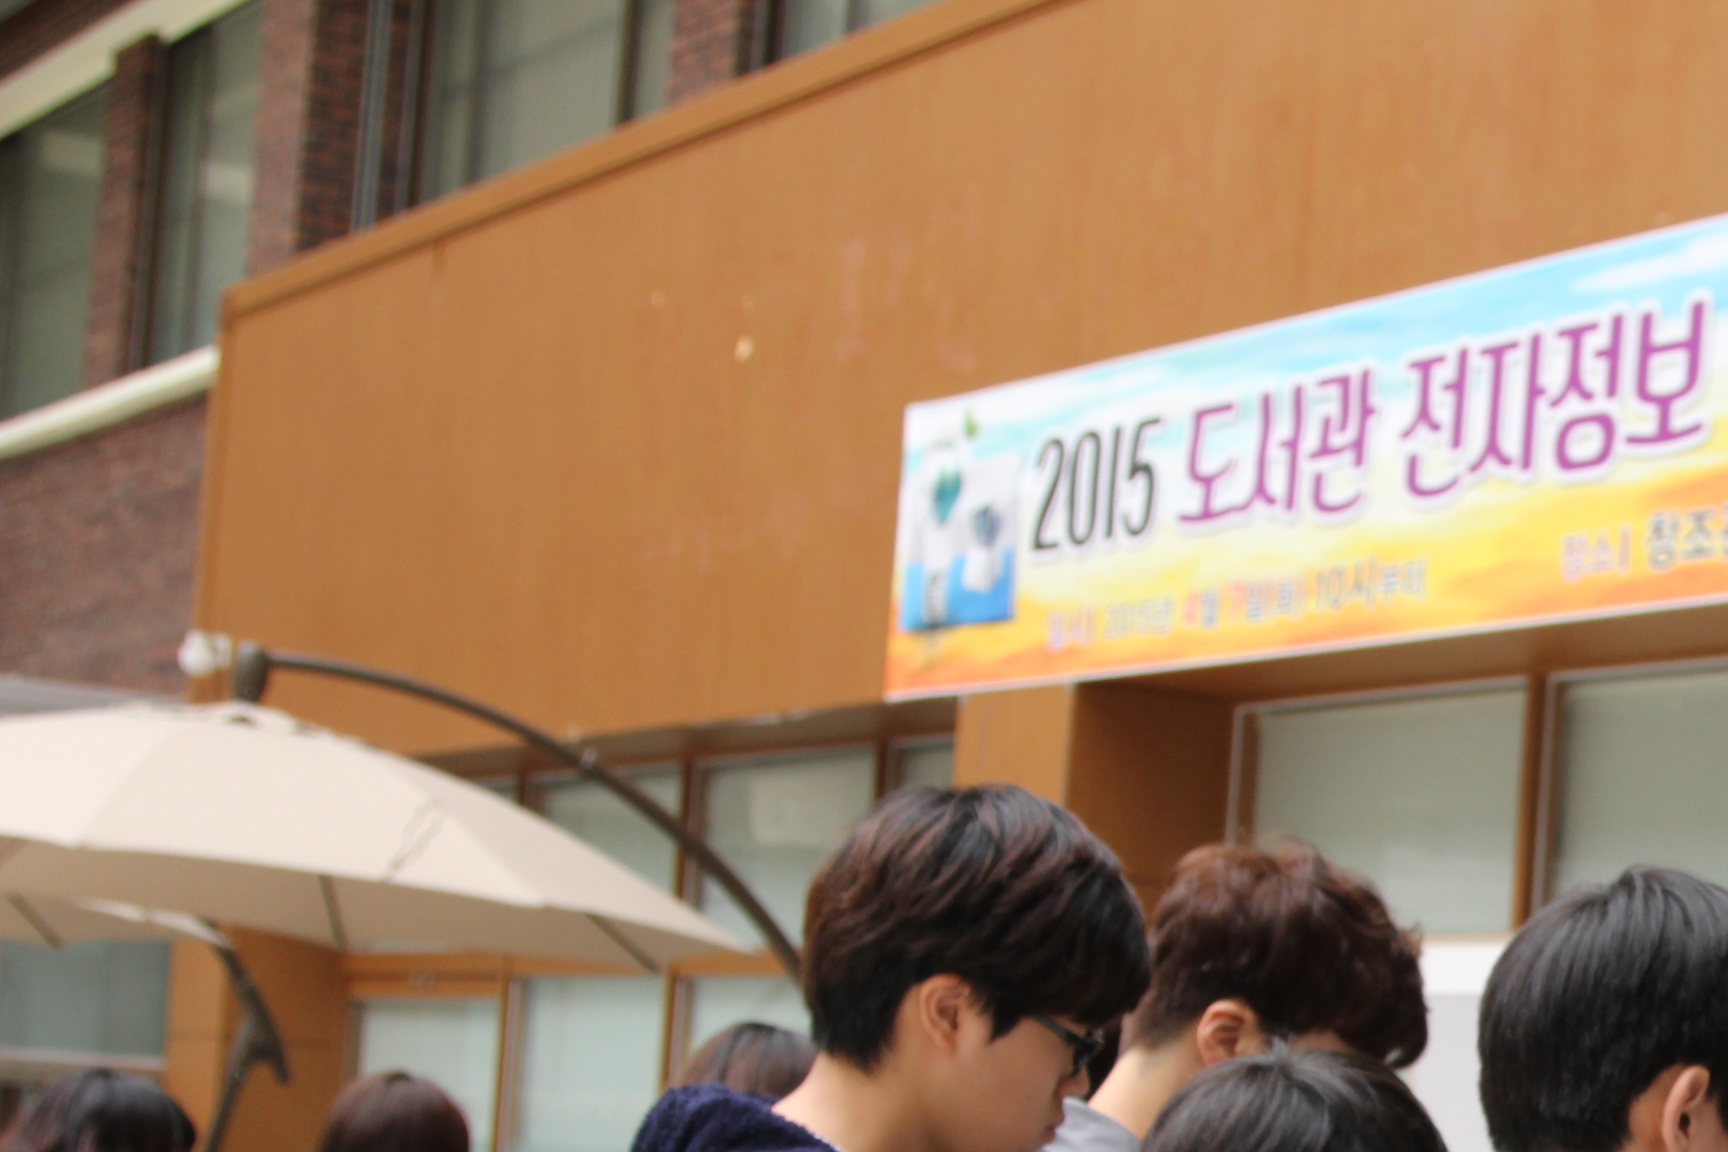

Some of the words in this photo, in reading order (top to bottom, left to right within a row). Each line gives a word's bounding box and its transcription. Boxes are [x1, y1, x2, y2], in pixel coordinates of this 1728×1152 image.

[1031, 416, 1162, 553] 2015
[1178, 368, 1377, 525] 도서관
[1400, 300, 1707, 498] 전자정보
